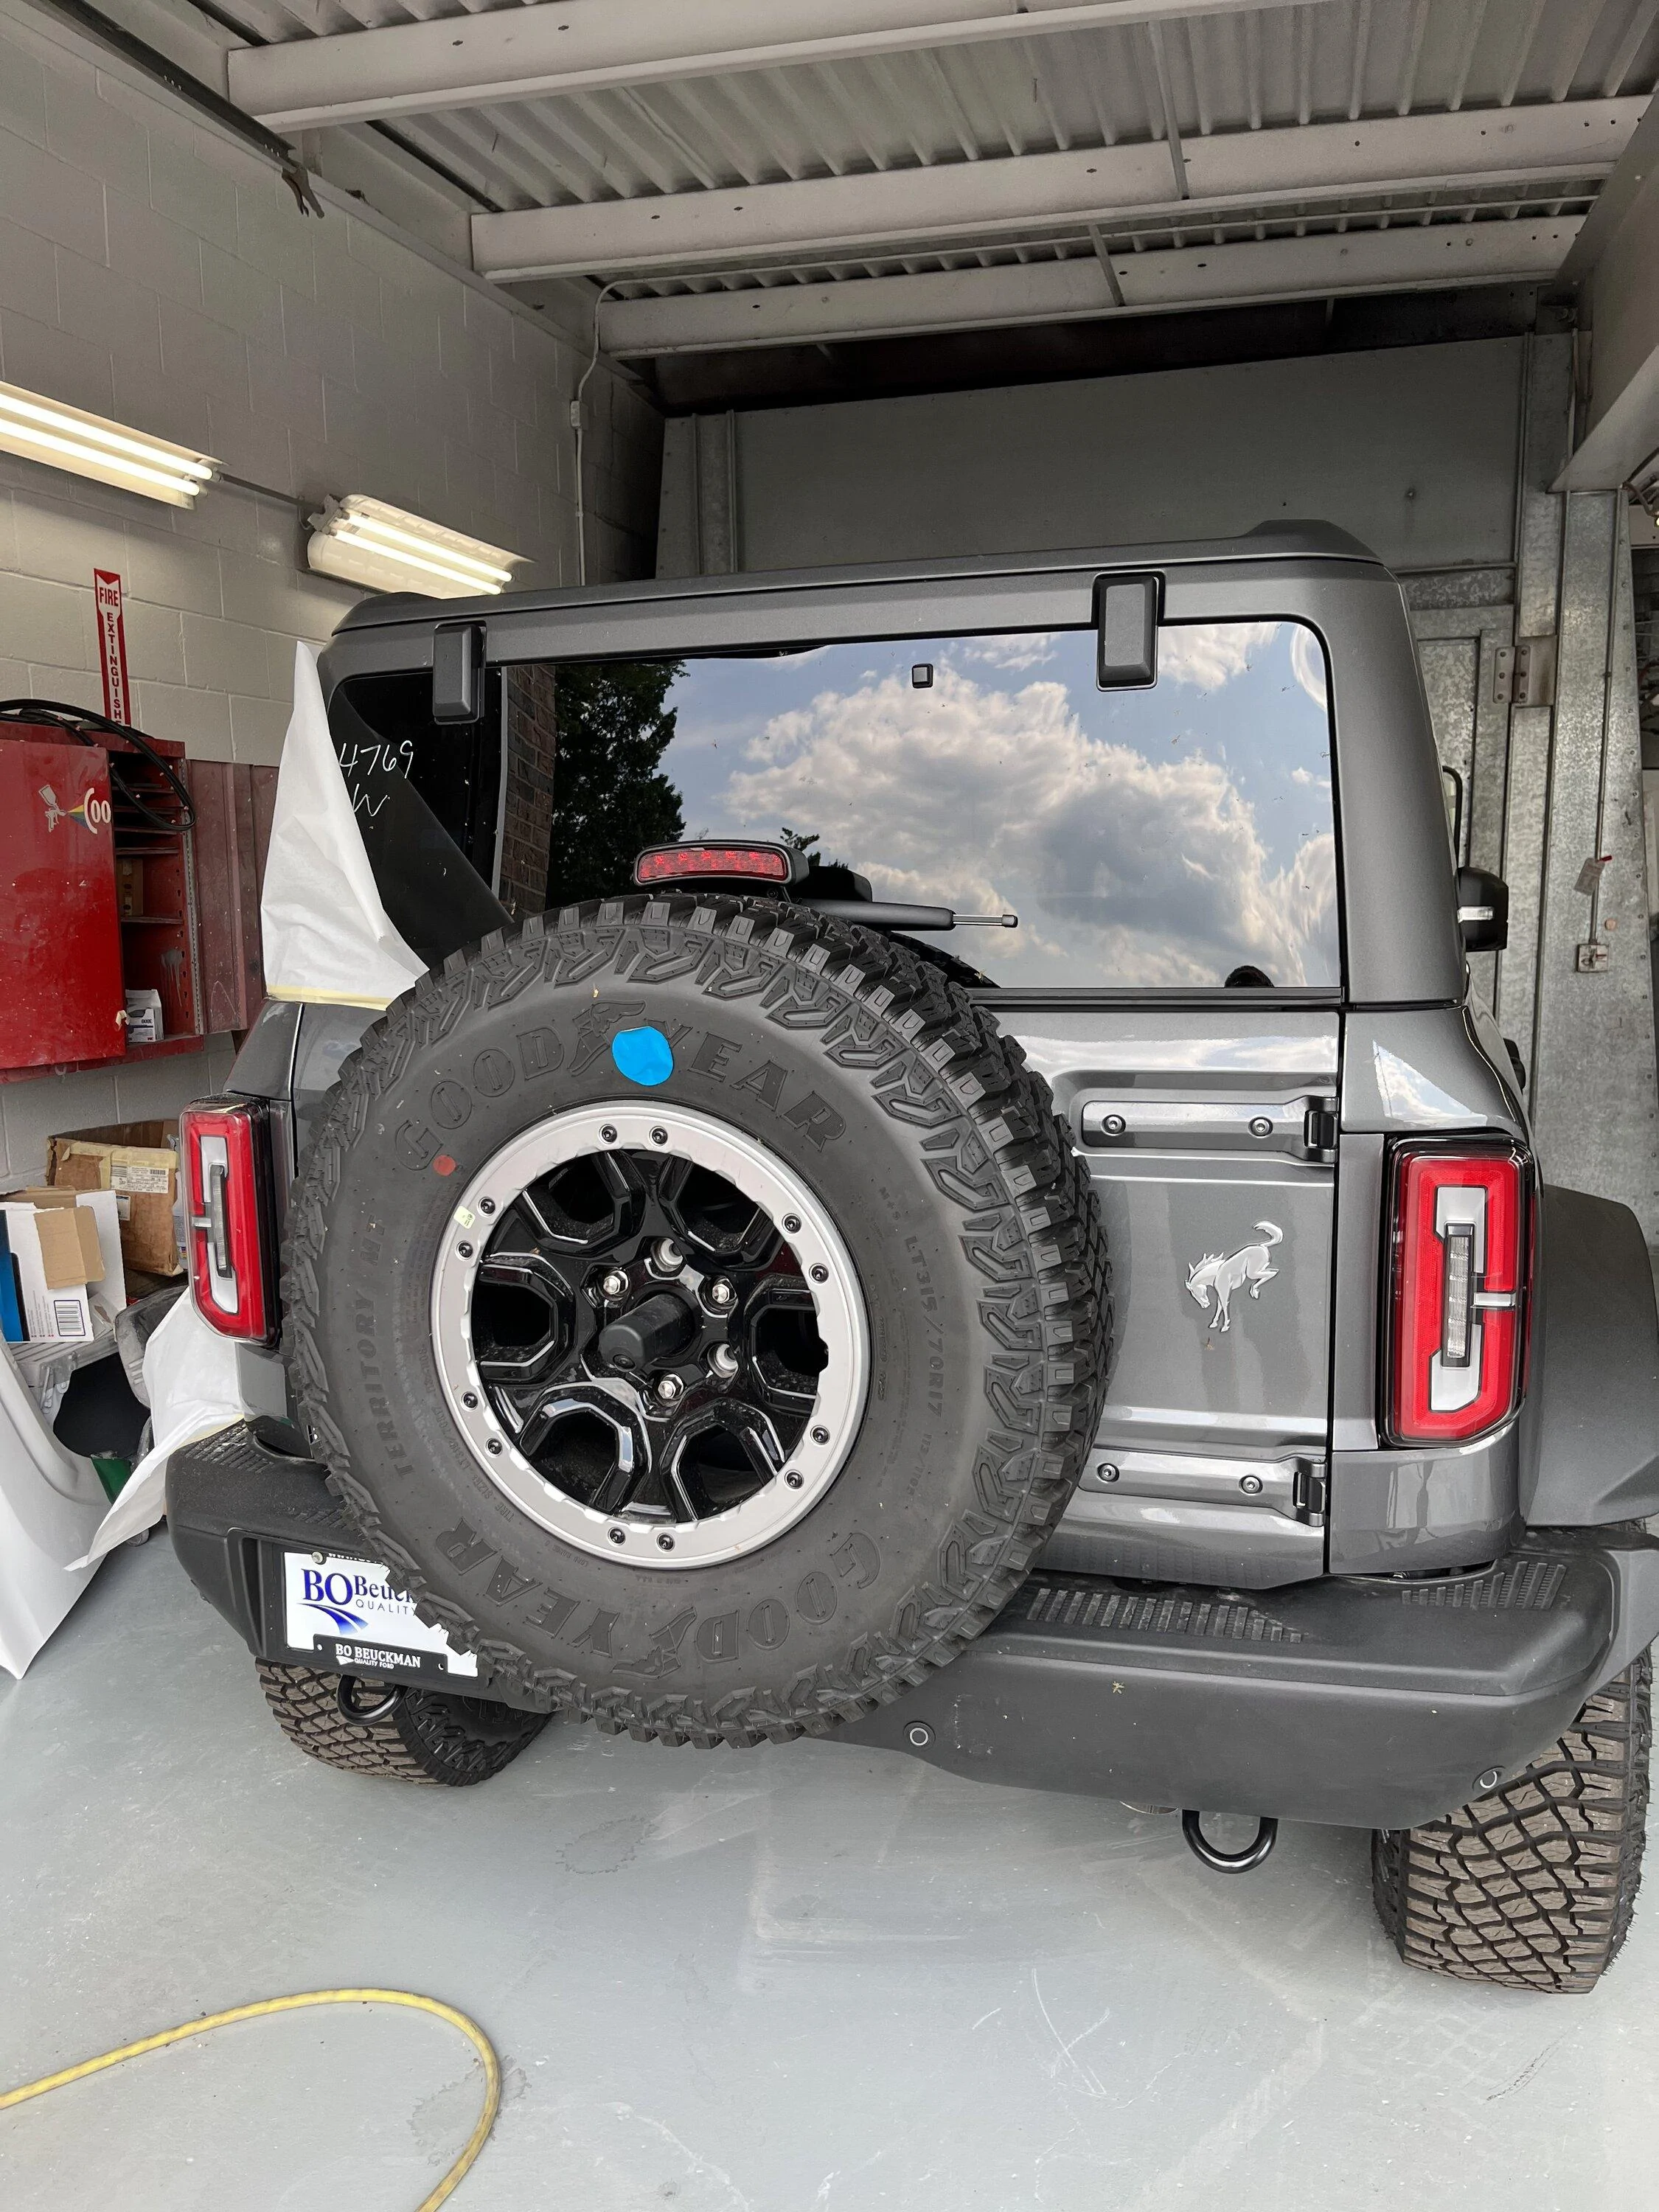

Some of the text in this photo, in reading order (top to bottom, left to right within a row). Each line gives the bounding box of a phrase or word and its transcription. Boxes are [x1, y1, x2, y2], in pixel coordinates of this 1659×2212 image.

[99, 587, 119, 607] FIRE
[107, 611, 122, 726] EXTINGUISH
[339, 740, 414, 779] 4769
[904, 1235, 945, 1418] LT315/70R17
[335, 1644, 421, 1668] BO BEUCKMAN
[355, 1658, 378, 1666] QUALITY
